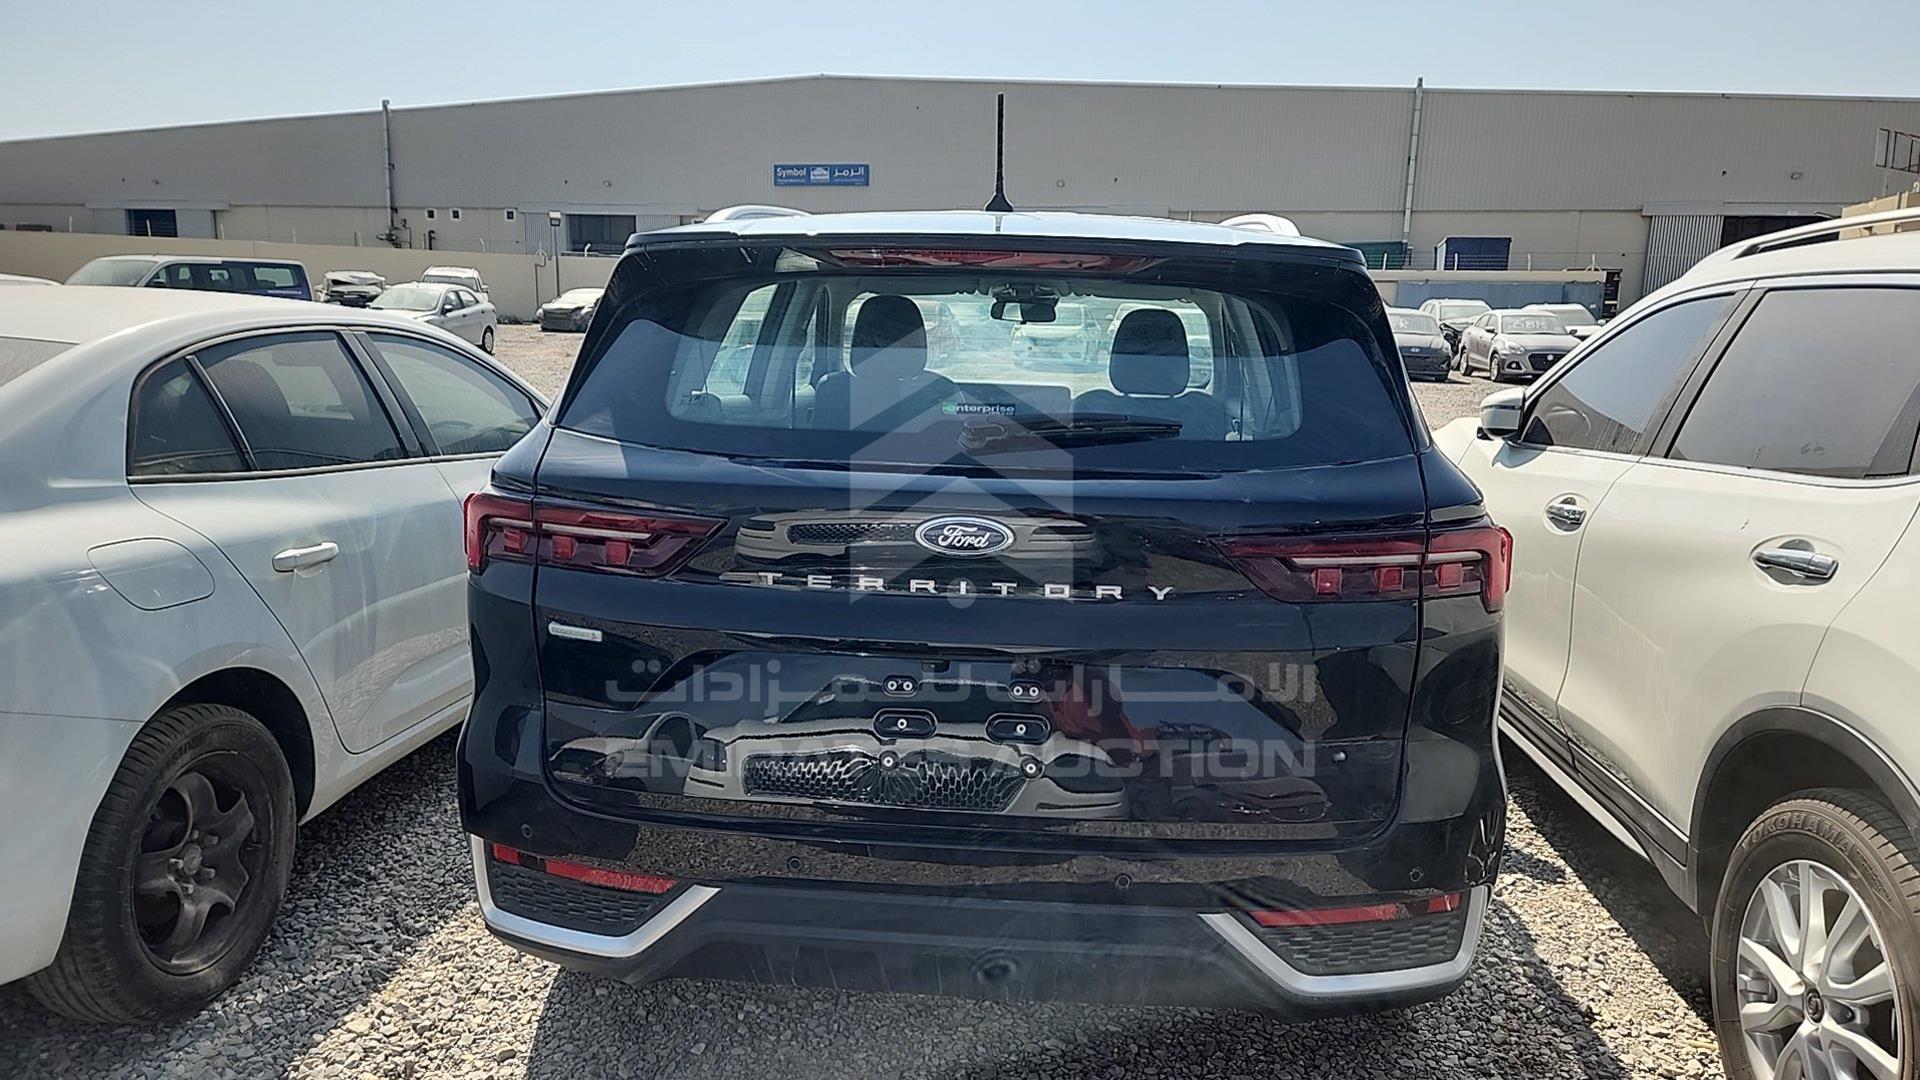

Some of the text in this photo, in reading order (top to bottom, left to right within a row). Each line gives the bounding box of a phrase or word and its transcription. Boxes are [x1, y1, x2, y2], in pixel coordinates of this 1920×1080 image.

[776, 167, 807, 178] Symbol
[943, 403, 1015, 414] enterprise
[937, 525, 991, 550] Ford
[758, 571, 1175, 600] TERRITORY
[1741, 811, 1855, 854] YOKOHAMA
